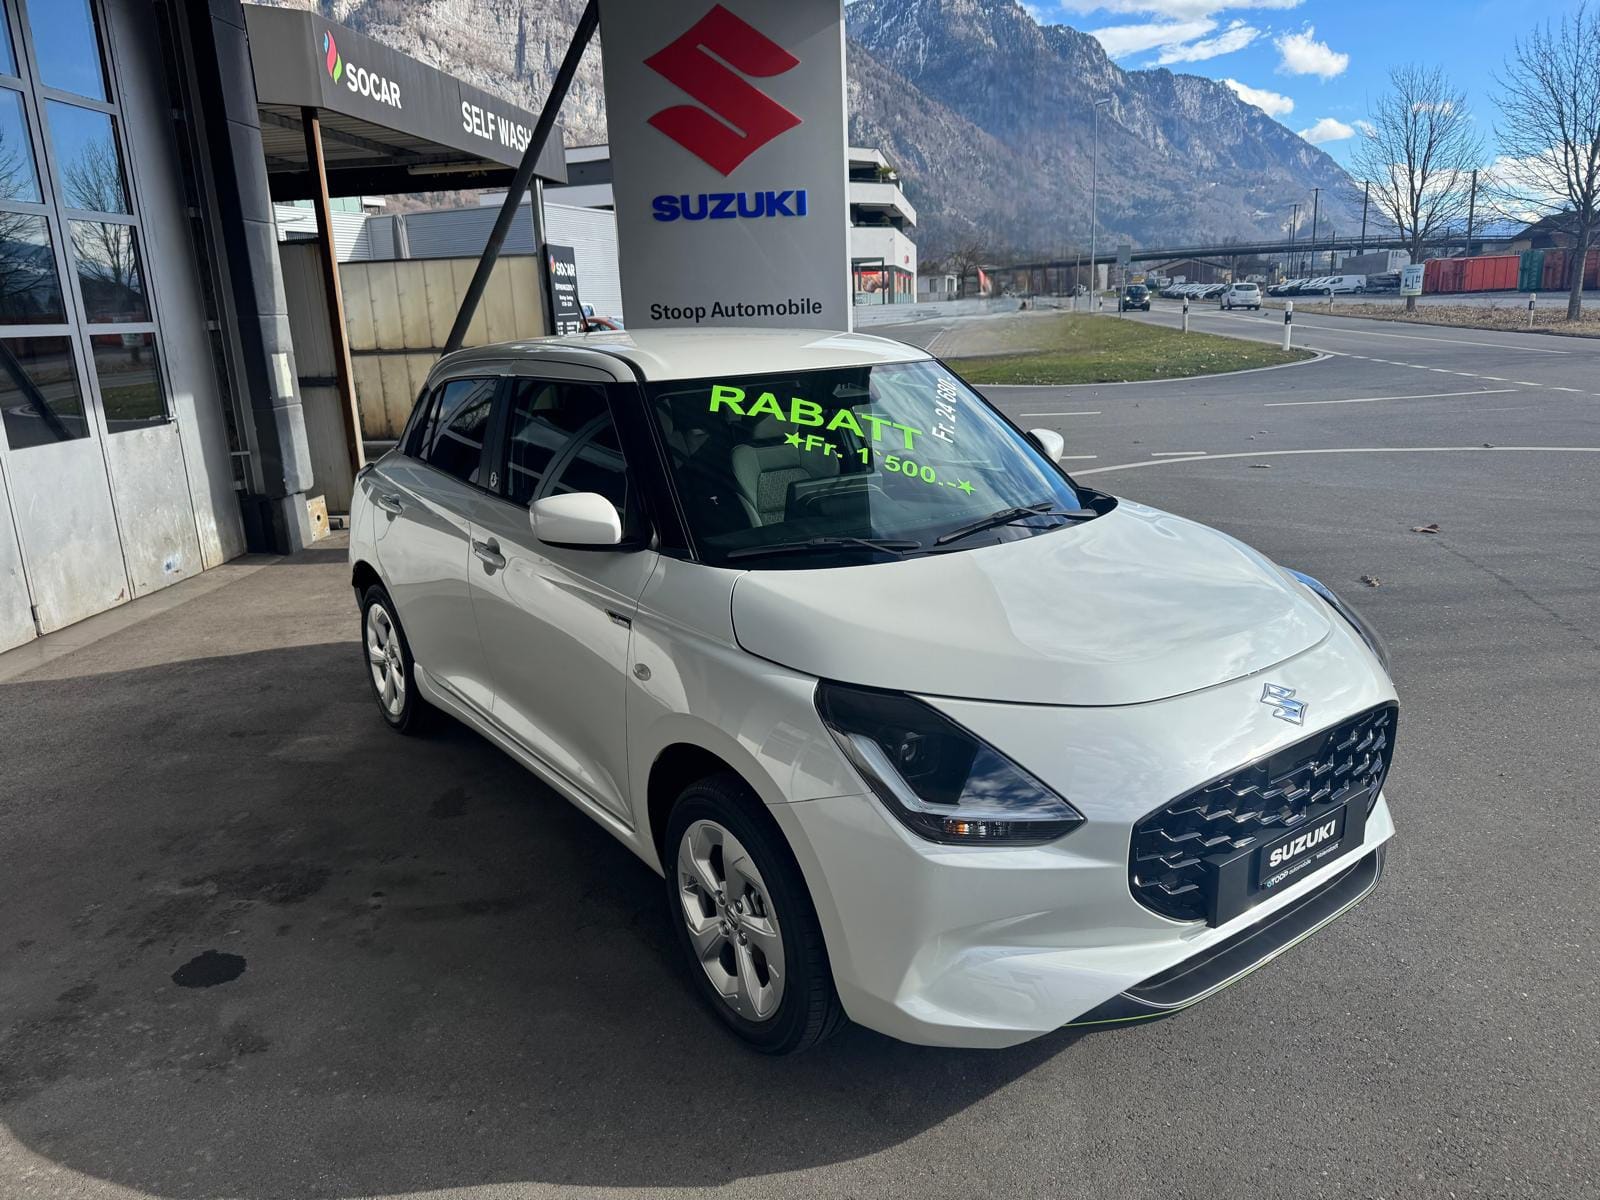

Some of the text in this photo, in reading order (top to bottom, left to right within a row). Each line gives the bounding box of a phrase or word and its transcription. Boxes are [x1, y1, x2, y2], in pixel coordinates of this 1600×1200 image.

[345, 62, 402, 109] SOCAR
[461, 101, 532, 152] SELF WASH
[652, 190, 807, 222] SUZUKI
[650, 298, 823, 323] Stoop Automobile
[709, 384, 923, 450] RABATT
[932, 425, 955, 444] Fr.
[805, 434, 843, 459] Fr.
[1269, 819, 1336, 867] SUZUKI
